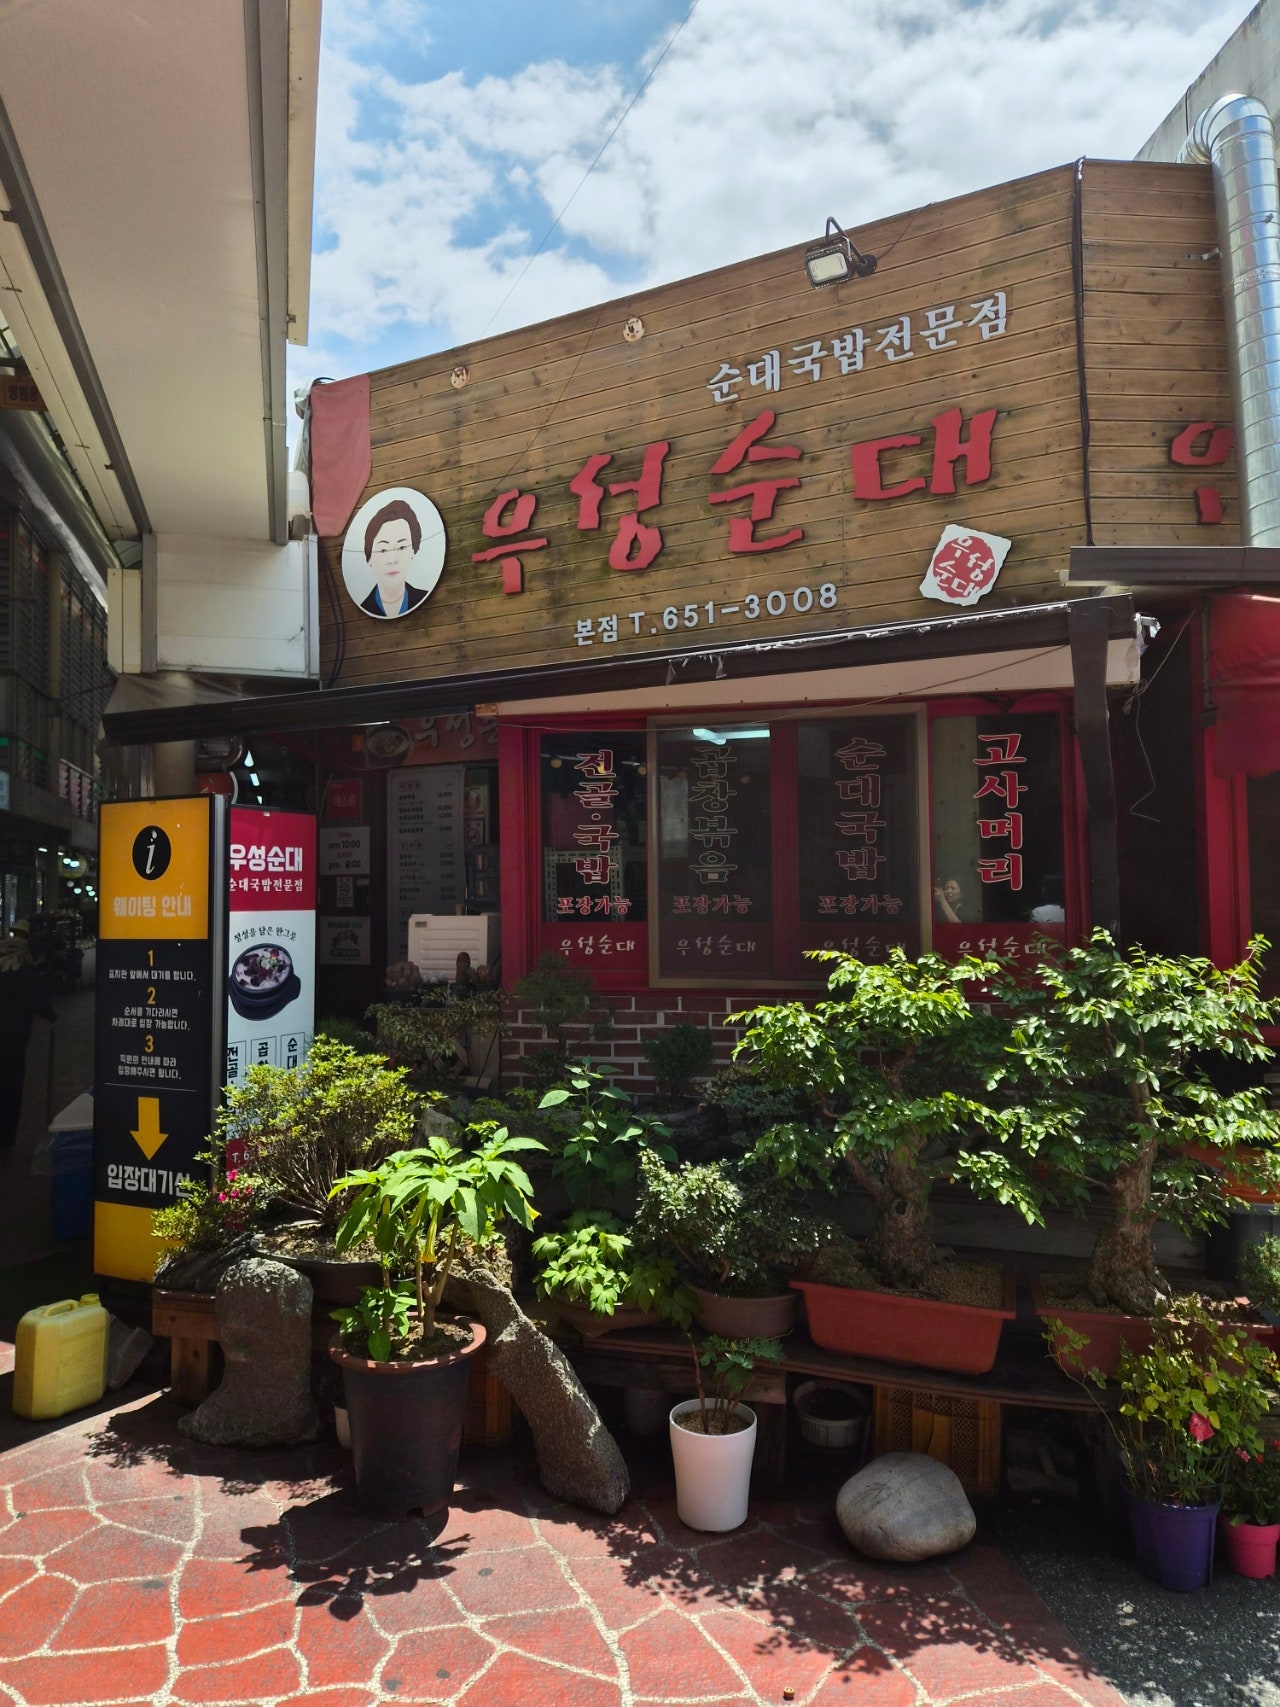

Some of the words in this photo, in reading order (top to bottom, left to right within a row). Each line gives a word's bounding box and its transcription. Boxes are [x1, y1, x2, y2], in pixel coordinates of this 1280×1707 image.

[706, 291, 1009, 403] 순대국밥전문점
[471, 407, 999, 595] 우성순대
[573, 614, 619, 646] 본점
[688, 747, 738, 884] 곱창볶음
[834, 737, 887, 881] 순대국밥
[972, 733, 1029, 890] 고사머리
[230, 844, 303, 873] 우성순대
[229, 877, 304, 892] 순대국밥전문점
[113, 895, 157, 918] 웨이팅
[161, 895, 192, 918] 안내
[556, 894, 632, 915] 포장가능
[673, 894, 753, 915] 포장가능
[817, 893, 904, 915] 포장가능
[559, 934, 636, 956] 우성순대
[676, 934, 757, 956] 우성순대
[147, 950, 154, 967] 1
[146, 986, 156, 1005] 2
[144, 1034, 155, 1053] 3
[107, 1163, 191, 1198] 입장대기선
